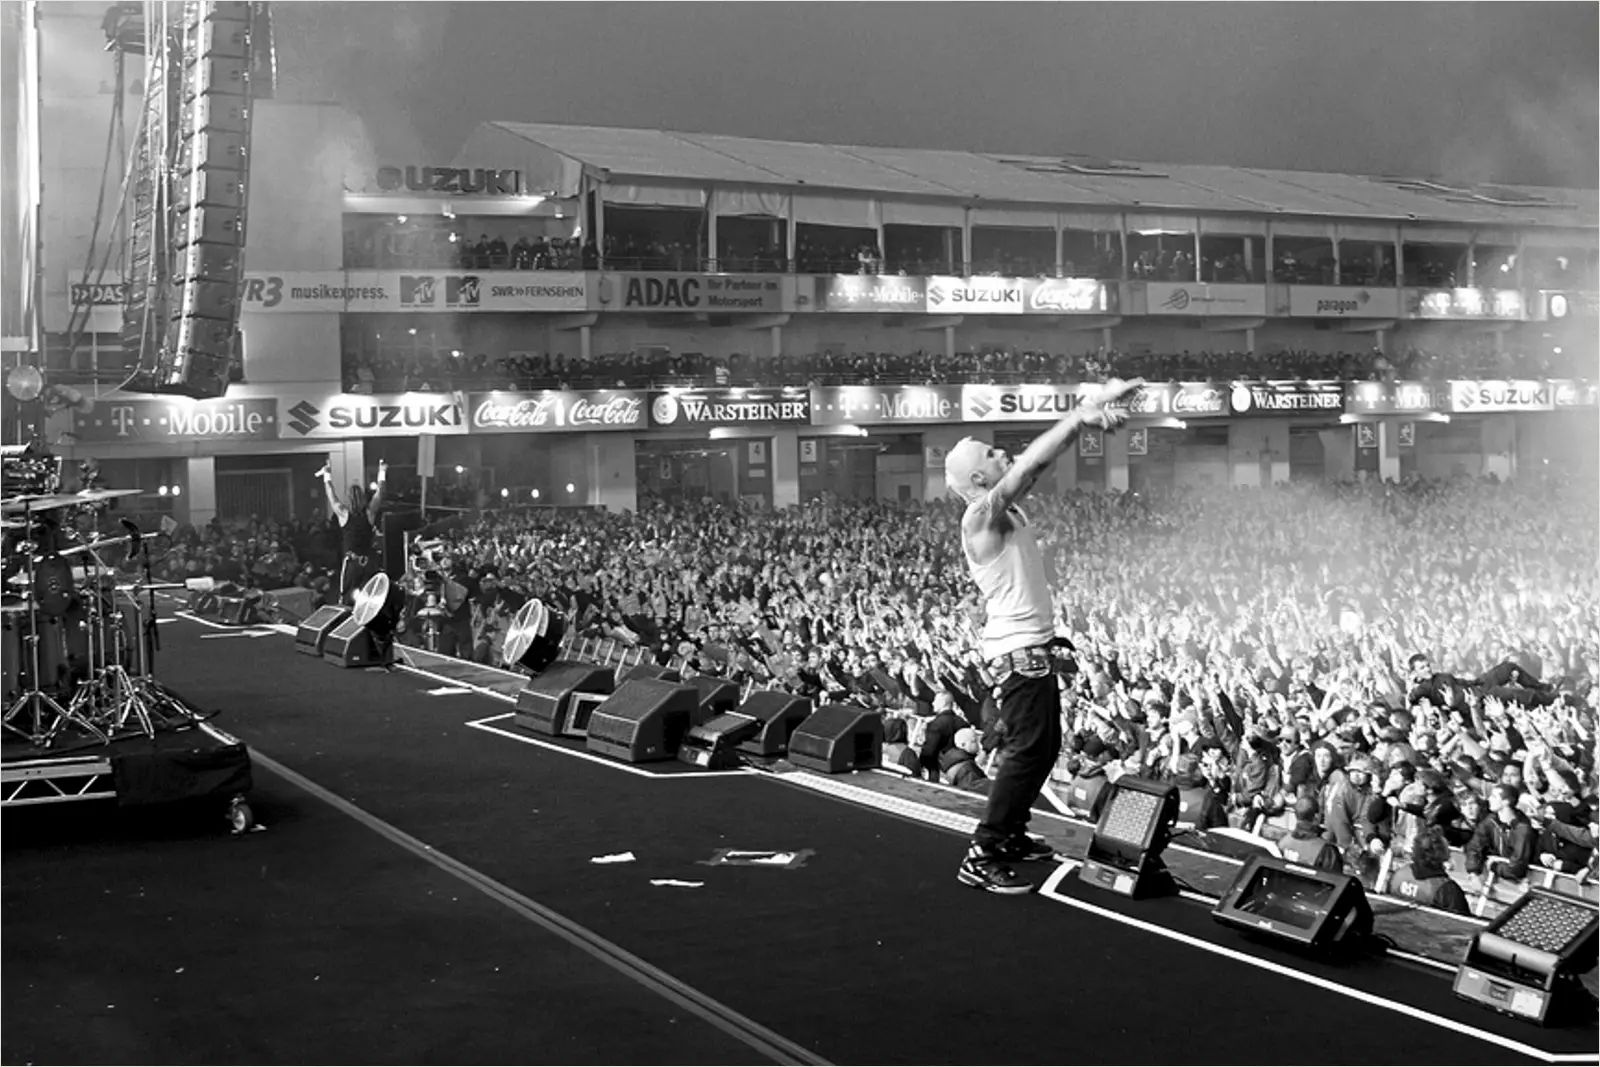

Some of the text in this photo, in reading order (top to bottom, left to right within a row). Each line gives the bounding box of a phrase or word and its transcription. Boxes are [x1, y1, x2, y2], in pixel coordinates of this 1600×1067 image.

[400, 276, 436, 303] MTV
[446, 275, 484, 303] MTV
[626, 278, 700, 307] ADAC
[708, 295, 762, 308] Motorsport
[951, 288, 1021, 303] SUZUKI
[999, 393, 1087, 413] SUZUK
[1251, 391, 1342, 409] WARSTEINER
[1479, 389, 1549, 405] SUZUKI
[111, 404, 262, 437] T Mobile
[328, 404, 462, 429] SUZUKI
[474, 398, 549, 427] Coca-Cola
[569, 396, 642, 426] Coca-Cola
[680, 401, 808, 422] WARSTEINER
